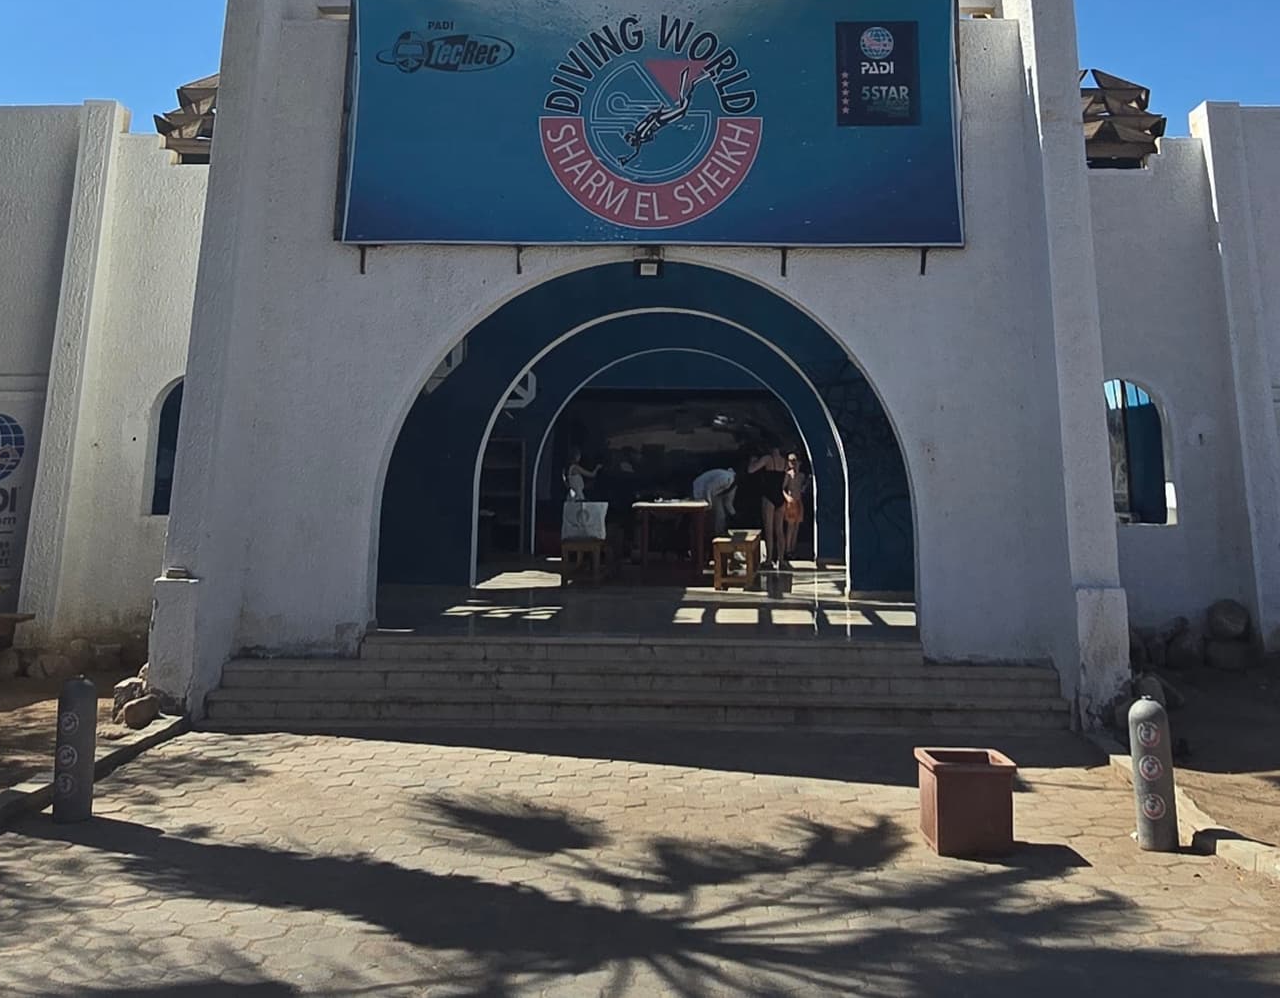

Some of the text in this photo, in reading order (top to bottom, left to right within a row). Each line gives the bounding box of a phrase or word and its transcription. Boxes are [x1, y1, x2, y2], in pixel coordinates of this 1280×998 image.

[427, 21, 454, 31] PADI
[429, 39, 501, 66] TecRec
[545, 15, 756, 114] DIVING WORLD
[860, 61, 895, 75] PADI
[546, 122, 754, 221] SHARM EL SHEIKH
